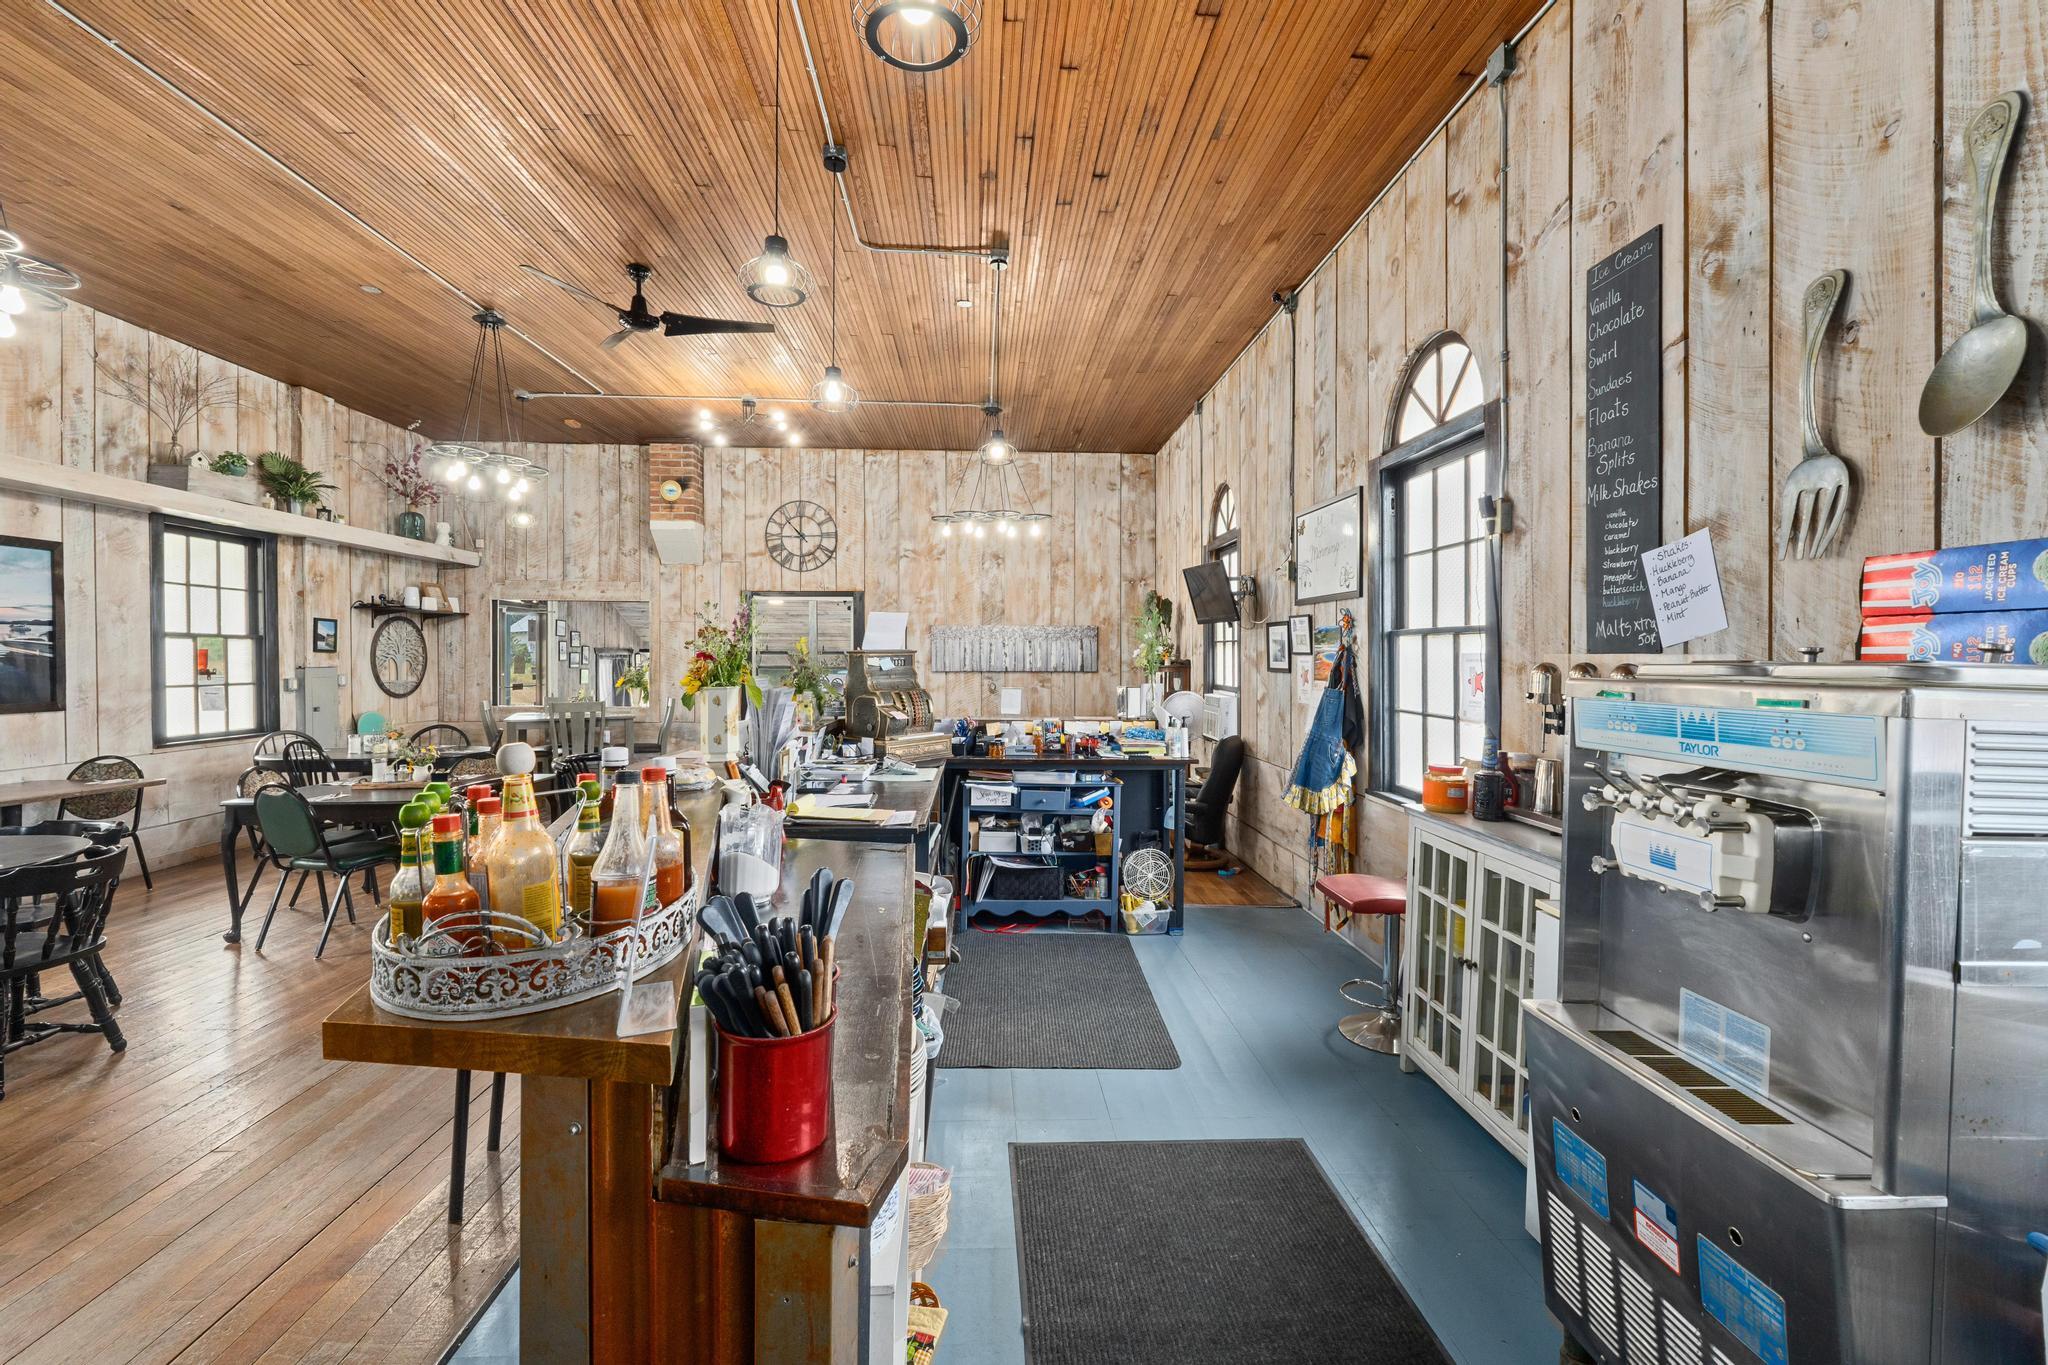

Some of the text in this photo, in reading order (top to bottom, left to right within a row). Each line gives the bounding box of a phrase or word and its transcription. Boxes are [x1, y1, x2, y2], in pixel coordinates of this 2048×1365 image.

[1592, 242, 1653, 284] Ice Cream
[1590, 288, 1622, 316] Vanilla
[1589, 301, 1645, 341] Chocolate
[1588, 340, 1617, 369] Swirl
[1588, 371, 1632, 400] Sundaes
[1589, 397, 1629, 428] Floats
[1588, 435, 1634, 458] Banana
[1596, 450, 1636, 475] Splits
[1587, 471, 1658, 508] Milk Shakes
[1604, 517, 1639, 530] chocolate
[1606, 507, 1627, 519] vanilla
[1604, 528, 1631, 541] caramel
[1604, 544, 1639, 557] blackberry
[1602, 559, 1638, 572] strawberry
[1652, 552, 1696, 577] Huckleberry
[1656, 567, 1692, 587] Banana
[1985, 553, 1997, 601] JACKETED
[1997, 551, 2010, 601] ICE CREAM
[2006, 563, 2017, 588] CUPS
[1602, 580, 1647, 596] butterscotch
[1603, 569, 1638, 586] pineapple
[1967, 564, 1983, 592] 112
[1660, 582, 1687, 599] Mango
[1663, 583, 1713, 612] Peanut Butter
[1595, 617, 1657, 639] Malts xtra
[1666, 607, 1689, 624] Mint
[1967, 636, 1982, 662] 112
[1678, 741, 1719, 757] TAYLOR
